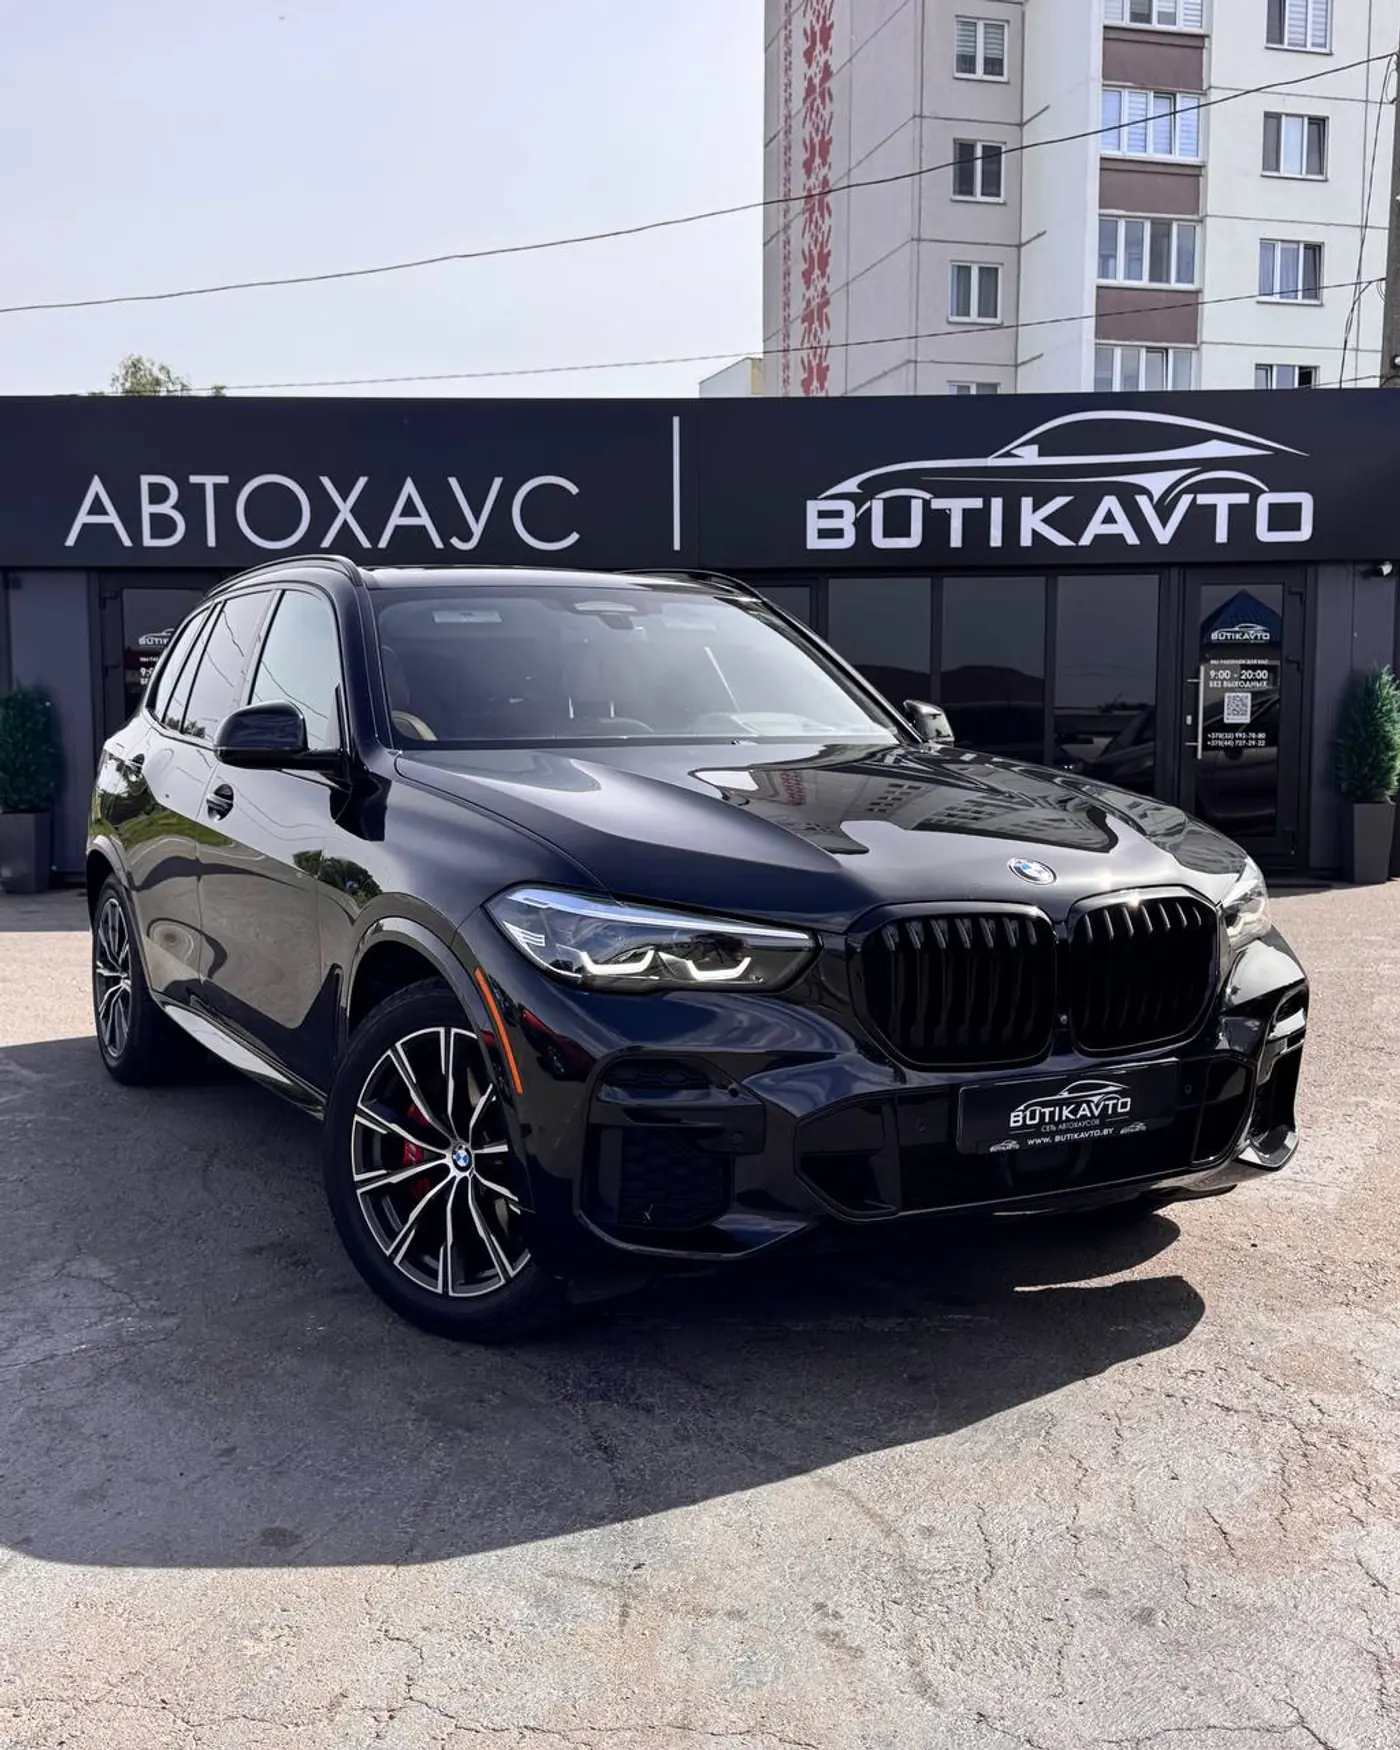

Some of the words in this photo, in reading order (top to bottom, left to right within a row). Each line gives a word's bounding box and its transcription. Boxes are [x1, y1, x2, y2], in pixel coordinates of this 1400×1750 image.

[64, 474, 581, 550] АВТОХАУС
[805, 490, 1314, 551] BUTIKAVTO
[1211, 632, 1270, 640] BUTIKAVTO
[1209, 670, 1231, 680] 9:00
[1240, 669, 1269, 680] 20:00
[1223, 680, 1268, 688] ВЫХОДНЫХ
[1009, 1097, 1131, 1128] BUTIKAVTO
[1058, 1118, 1100, 1130] АВТОХАУСОВ
[1054, 1127, 1114, 1142] BUTIKAVTO.BY
